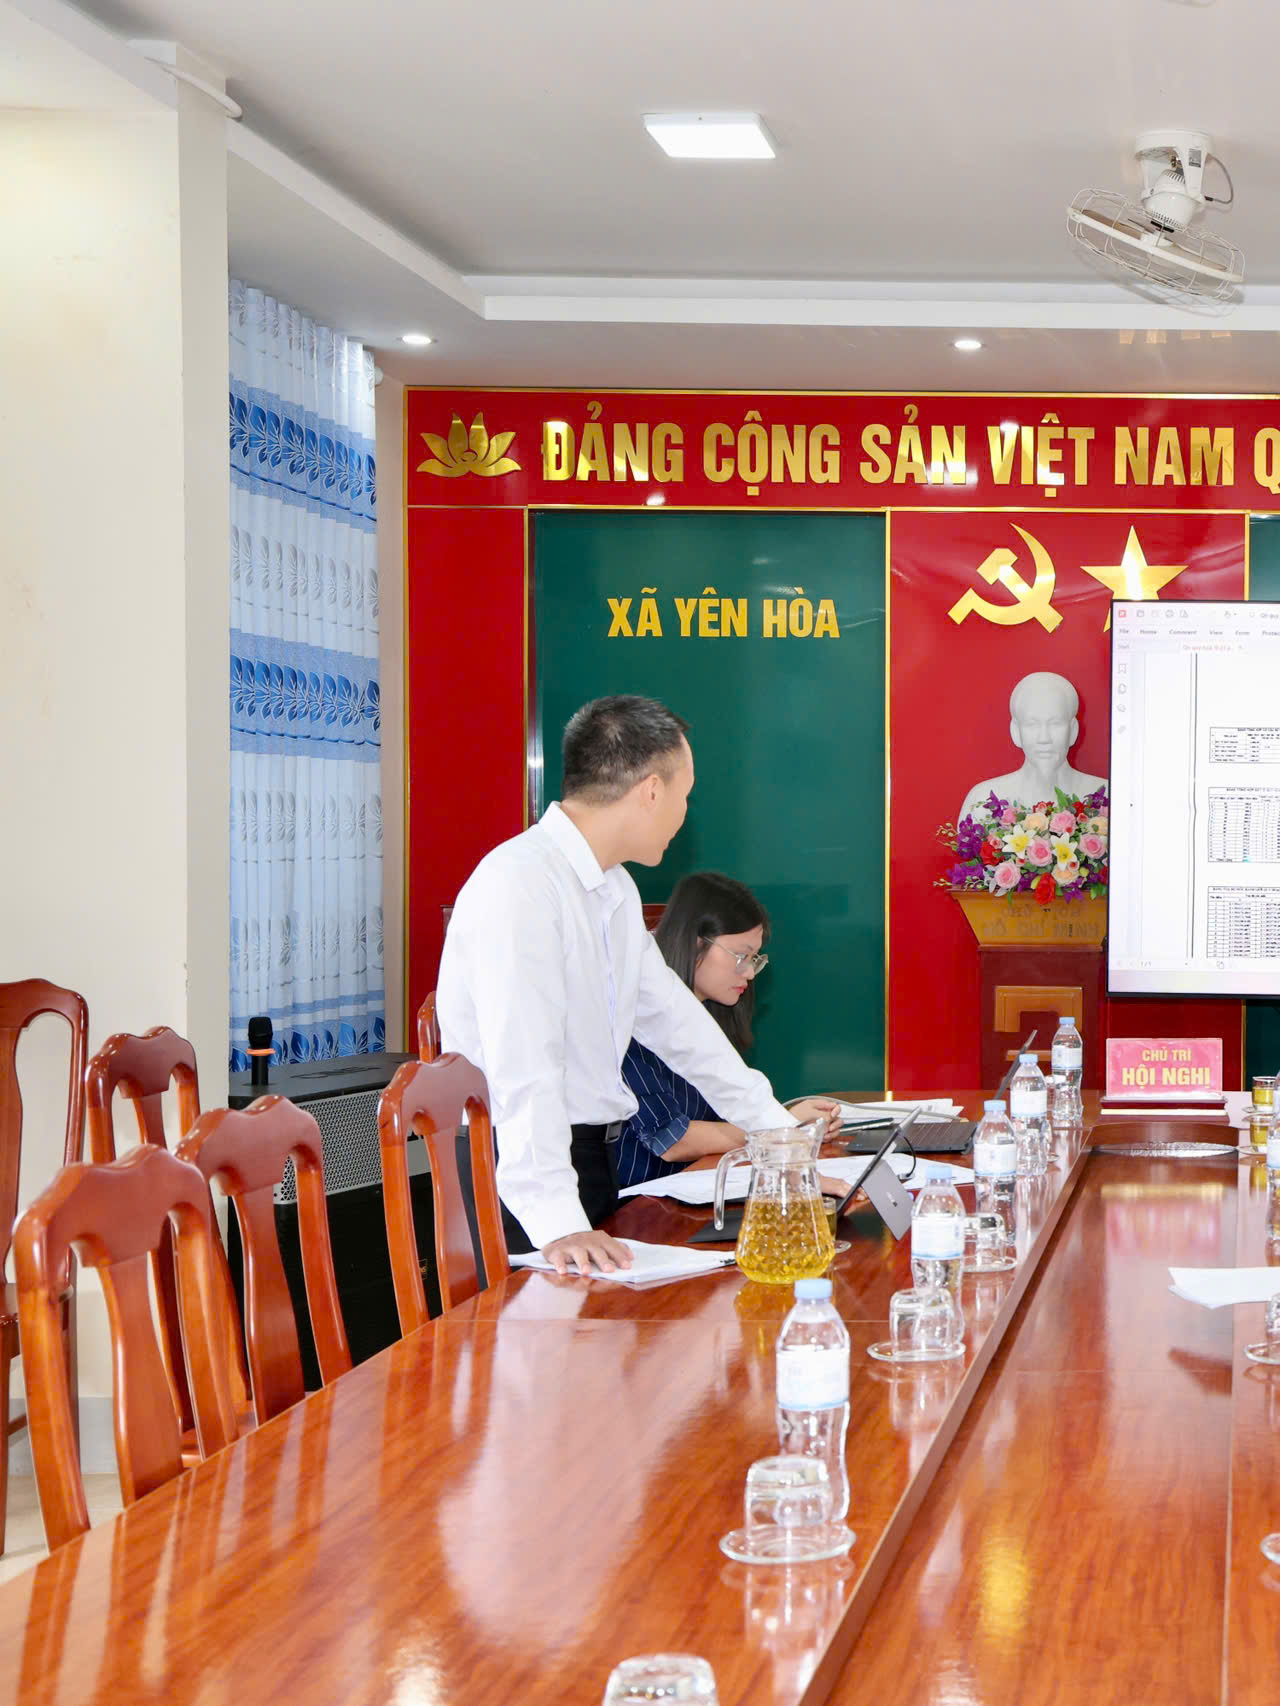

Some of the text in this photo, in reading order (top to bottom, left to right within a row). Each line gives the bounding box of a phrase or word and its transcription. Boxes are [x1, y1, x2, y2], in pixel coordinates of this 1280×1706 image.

[541, 401, 684, 482] ĐẢNG
[703, 410, 840, 496] CỘNG
[859, 403, 966, 485] SẢN
[987, 412, 1095, 497] VIỆT
[1115, 426, 1234, 486] NAM
[607, 586, 841, 638] XÃ YÊN HÒA
[1141, 1046, 1192, 1061] CHỦ TRÌ
[1121, 1064, 1211, 1089] HỘI NGHỊ
